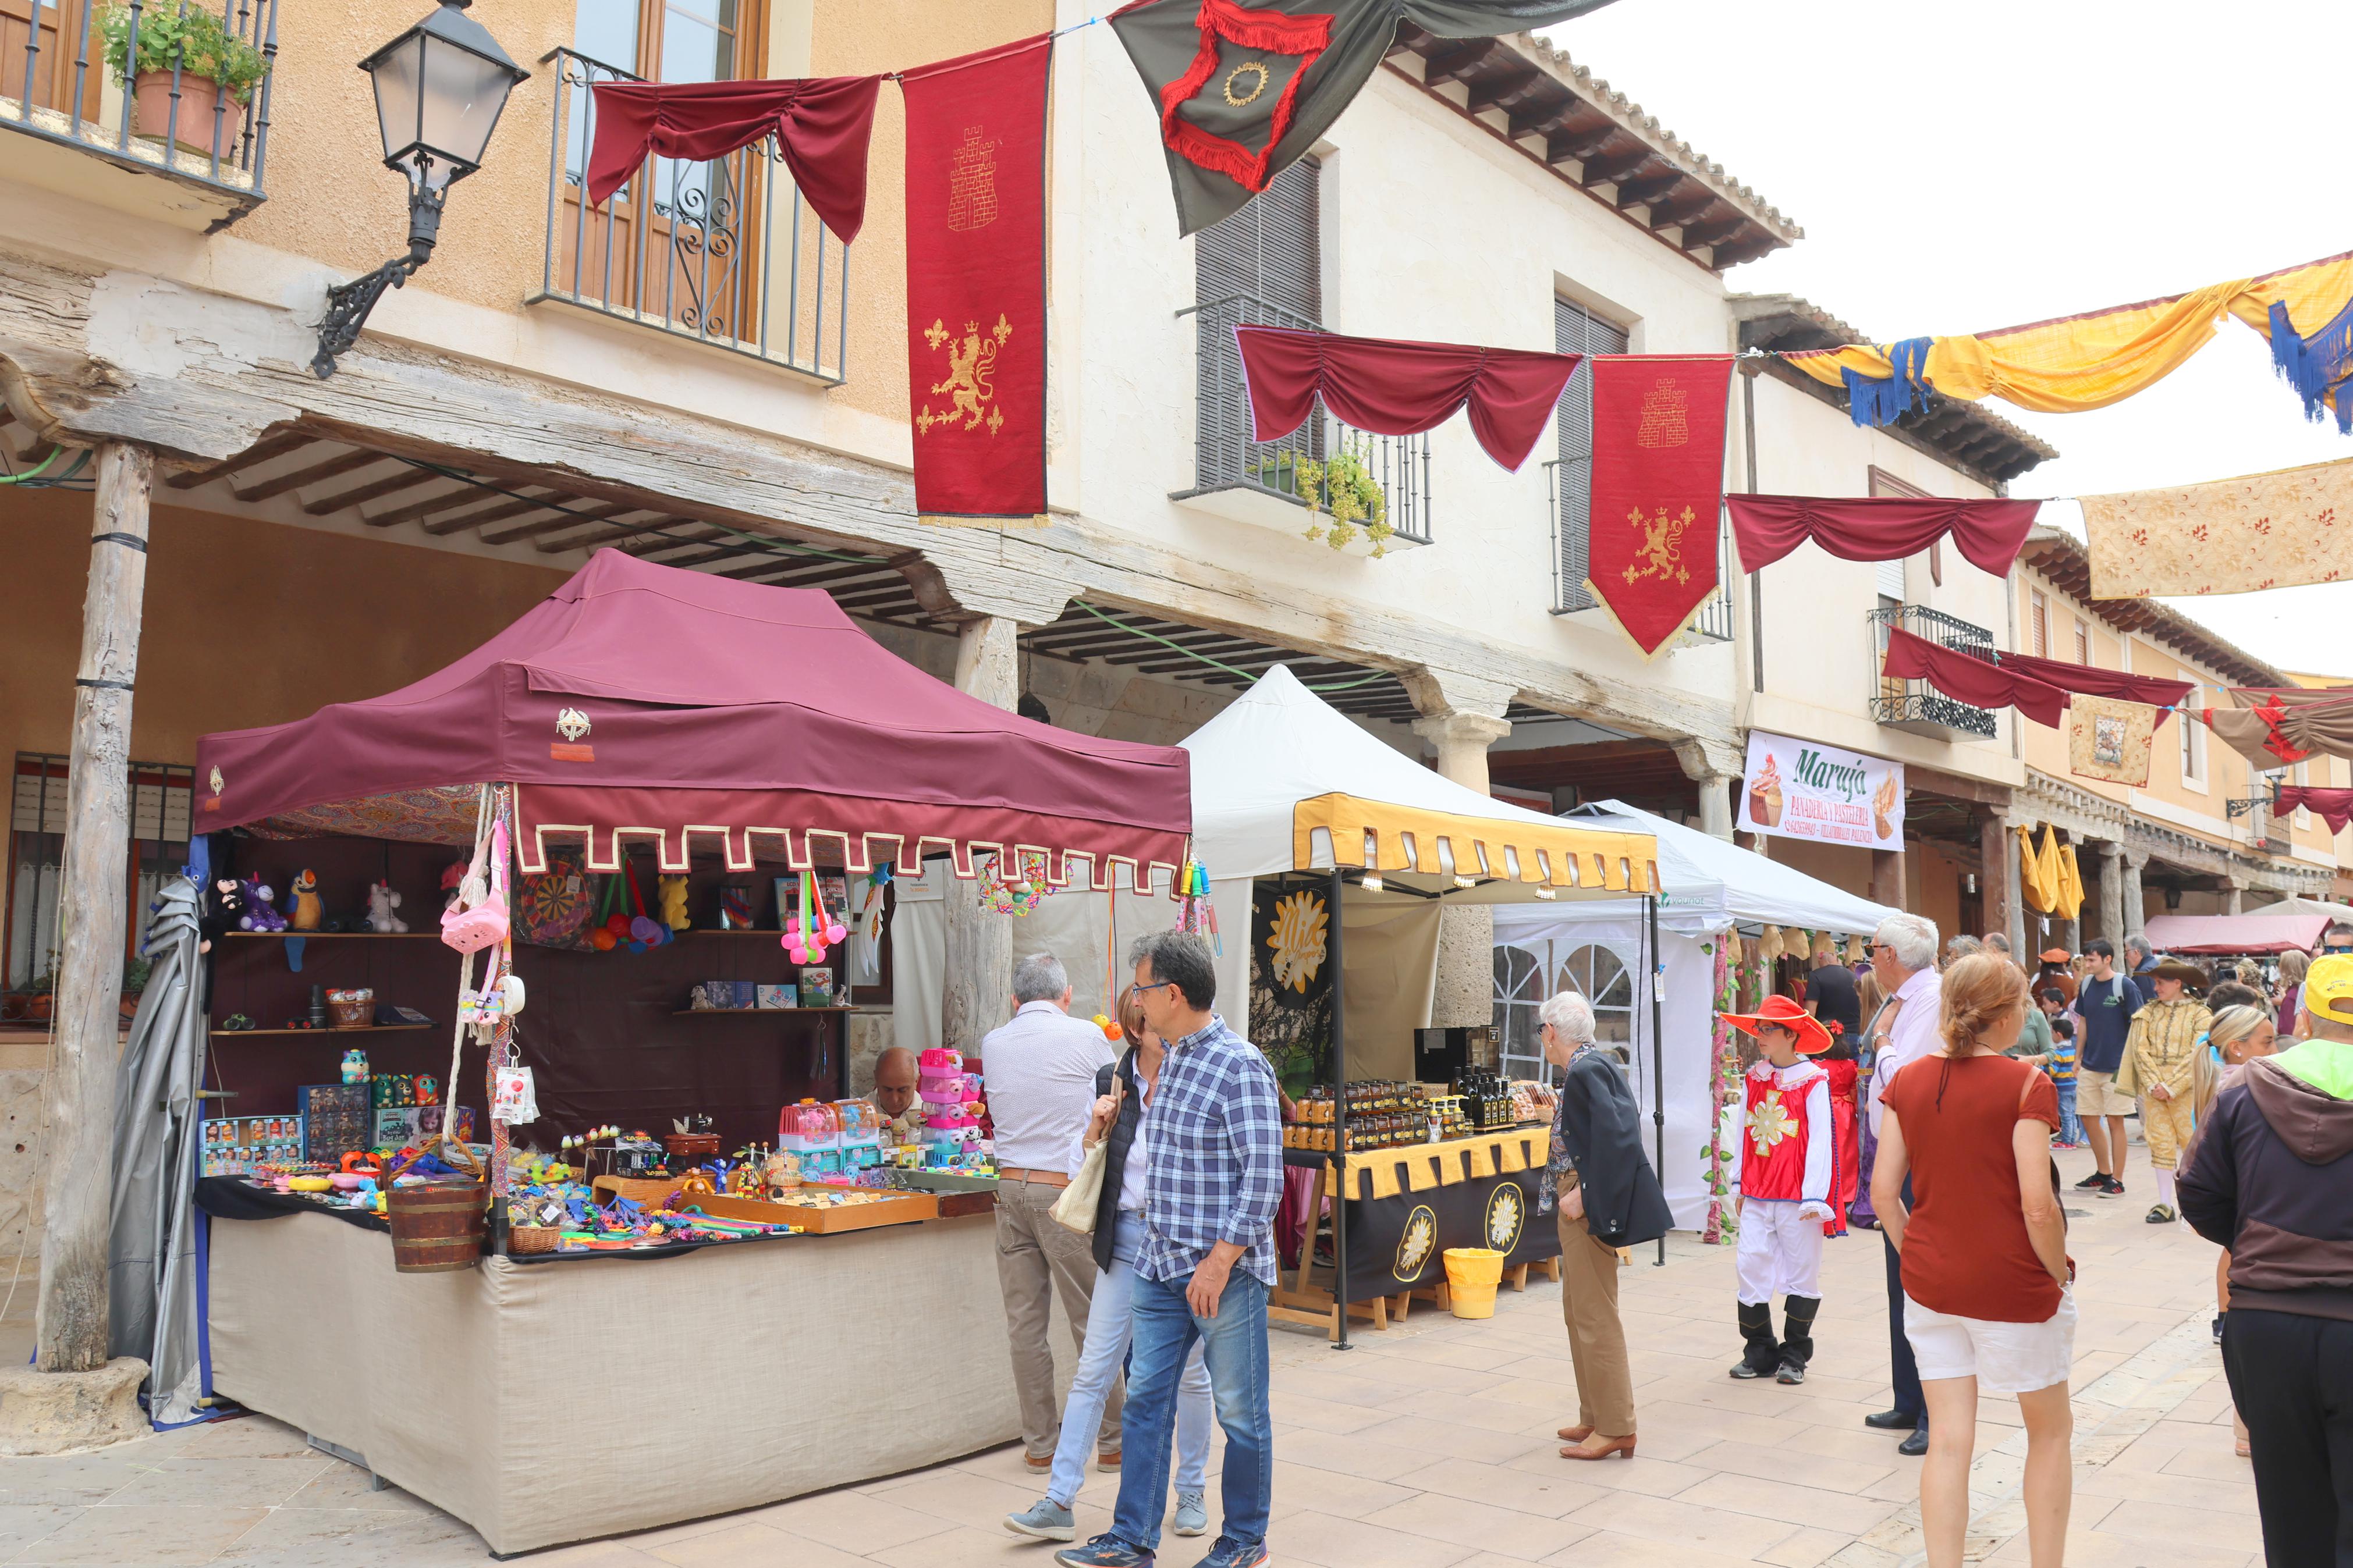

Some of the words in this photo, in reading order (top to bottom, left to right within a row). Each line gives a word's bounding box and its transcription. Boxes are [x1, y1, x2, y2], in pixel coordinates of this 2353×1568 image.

[1793, 749, 1867, 803] Maruja
[1791, 796, 1828, 820] PANADERIA
[1828, 802, 1833, 821] Y
[1834, 802, 1869, 826] PASTELERIA
[1851, 828, 1872, 843] PALENCIA
